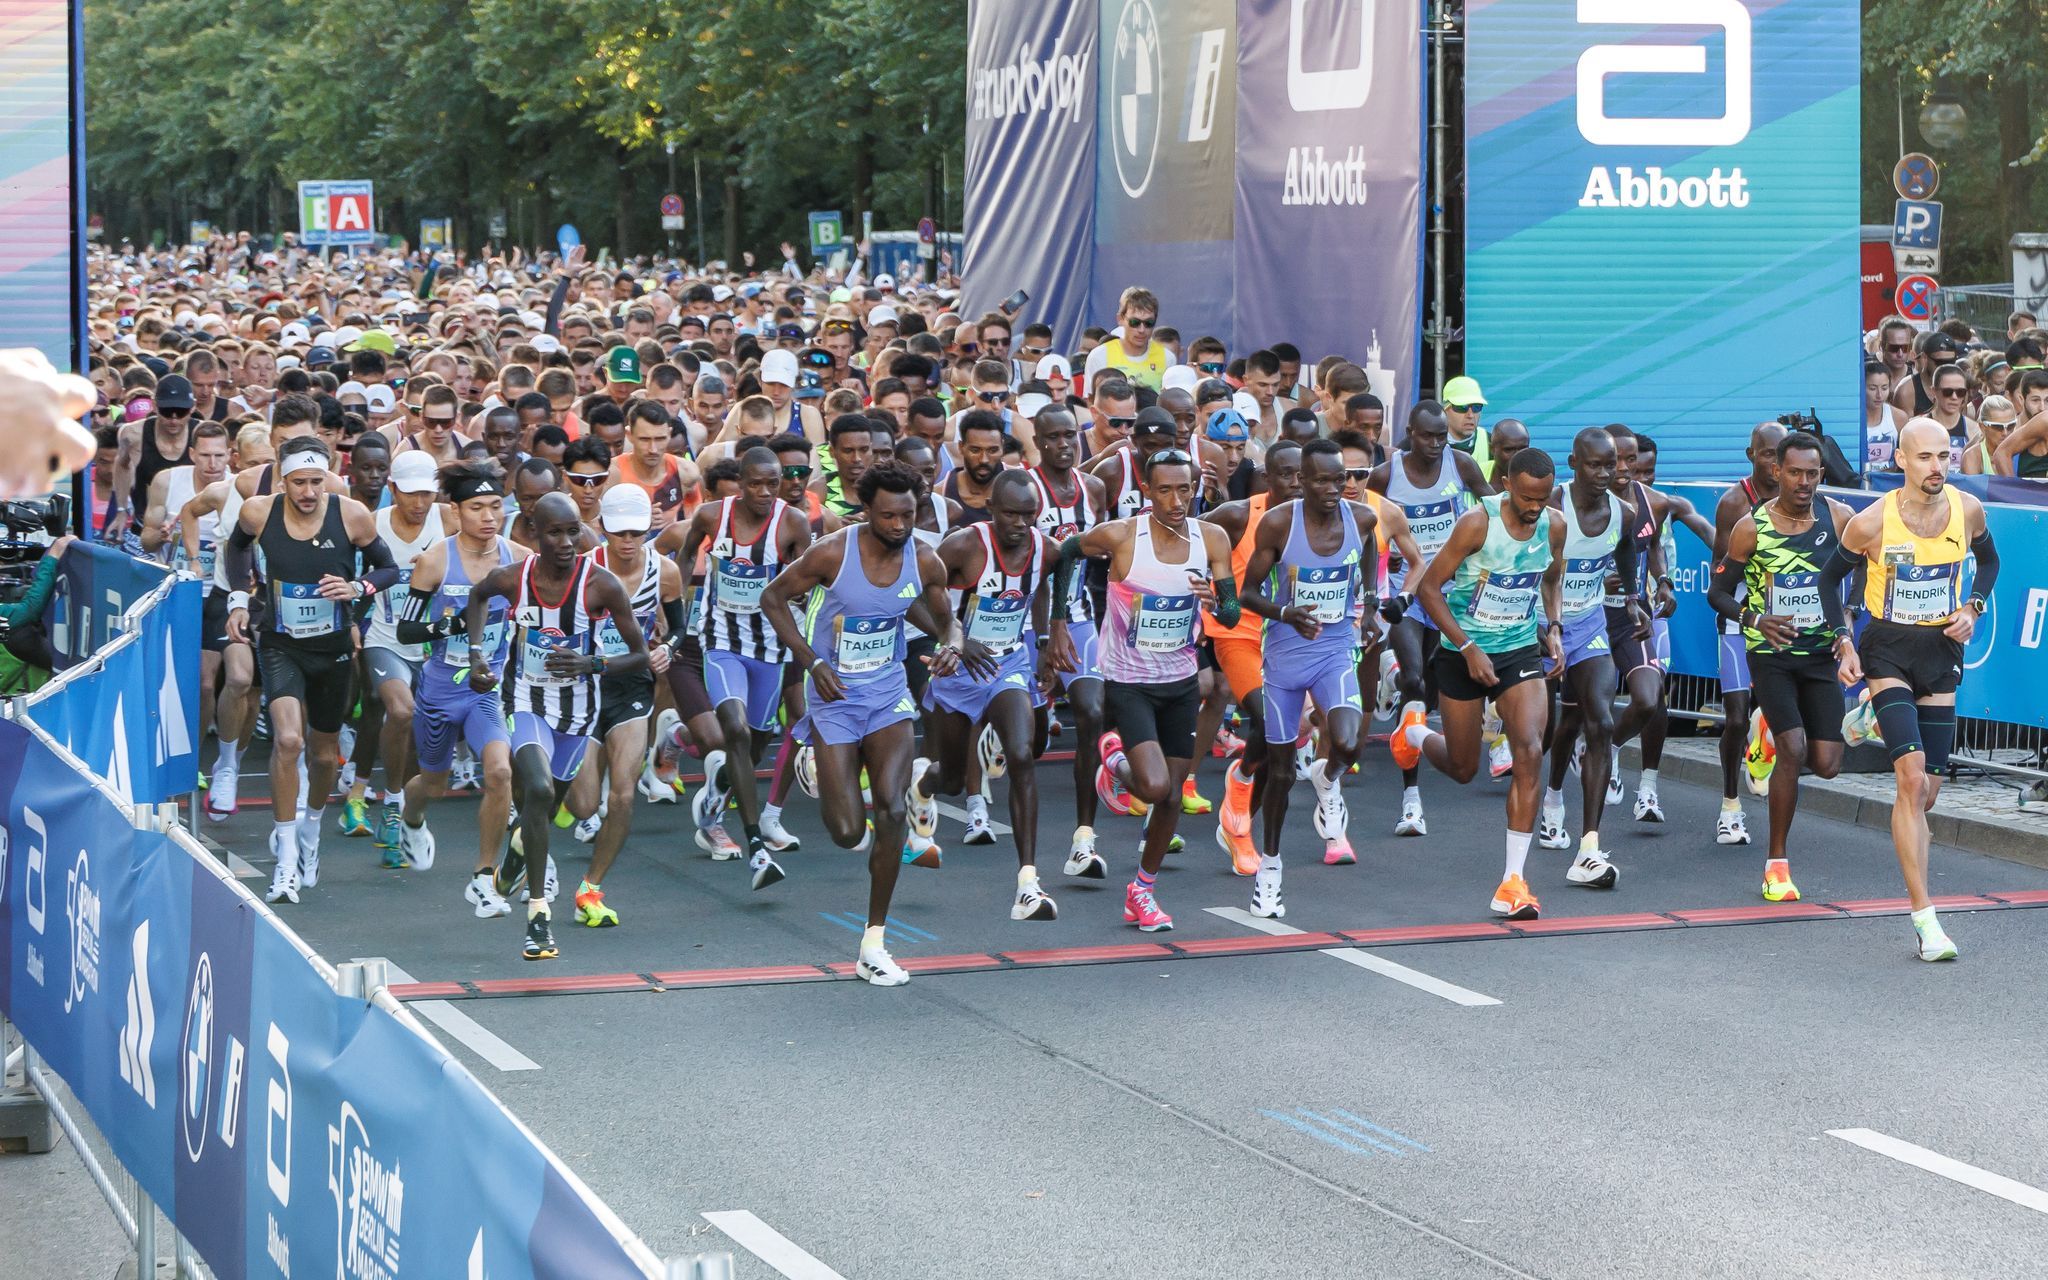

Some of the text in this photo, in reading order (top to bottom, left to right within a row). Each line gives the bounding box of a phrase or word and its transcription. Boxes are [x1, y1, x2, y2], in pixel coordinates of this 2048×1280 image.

[1282, 146, 1367, 206] Abbott
[1578, 166, 1749, 208] Abbott
[335, 197, 365, 230] A
[1905, 206, 1931, 237] P
[817, 222, 836, 245] B
[1409, 519, 1453, 534] KIPROP
[721, 576, 764, 590] KIBITOK
[1673, 567, 1697, 593] eer
[1297, 587, 1346, 601] KANDIE
[1483, 591, 1530, 604] MENGESHA
[1778, 593, 1820, 606] KIROS
[1896, 586, 1947, 600] HENDRIK
[299, 605, 316, 616] 111
[1476, 611, 1489, 619] YOU
[1894, 611, 1906, 620] YOU
[1921, 612, 1934, 620] THIS
[1141, 616, 1190, 629] LEGESE
[455, 632, 495, 645] IKDA
[843, 635, 894, 651] TAKELE
[1137, 639, 1150, 647] YOU
[1164, 641, 1176, 649] THIS
[841, 660, 880, 671] YOU GOT THIS
[361, 1150, 390, 1219] BMW
[358, 1205, 386, 1259] BERLIN
